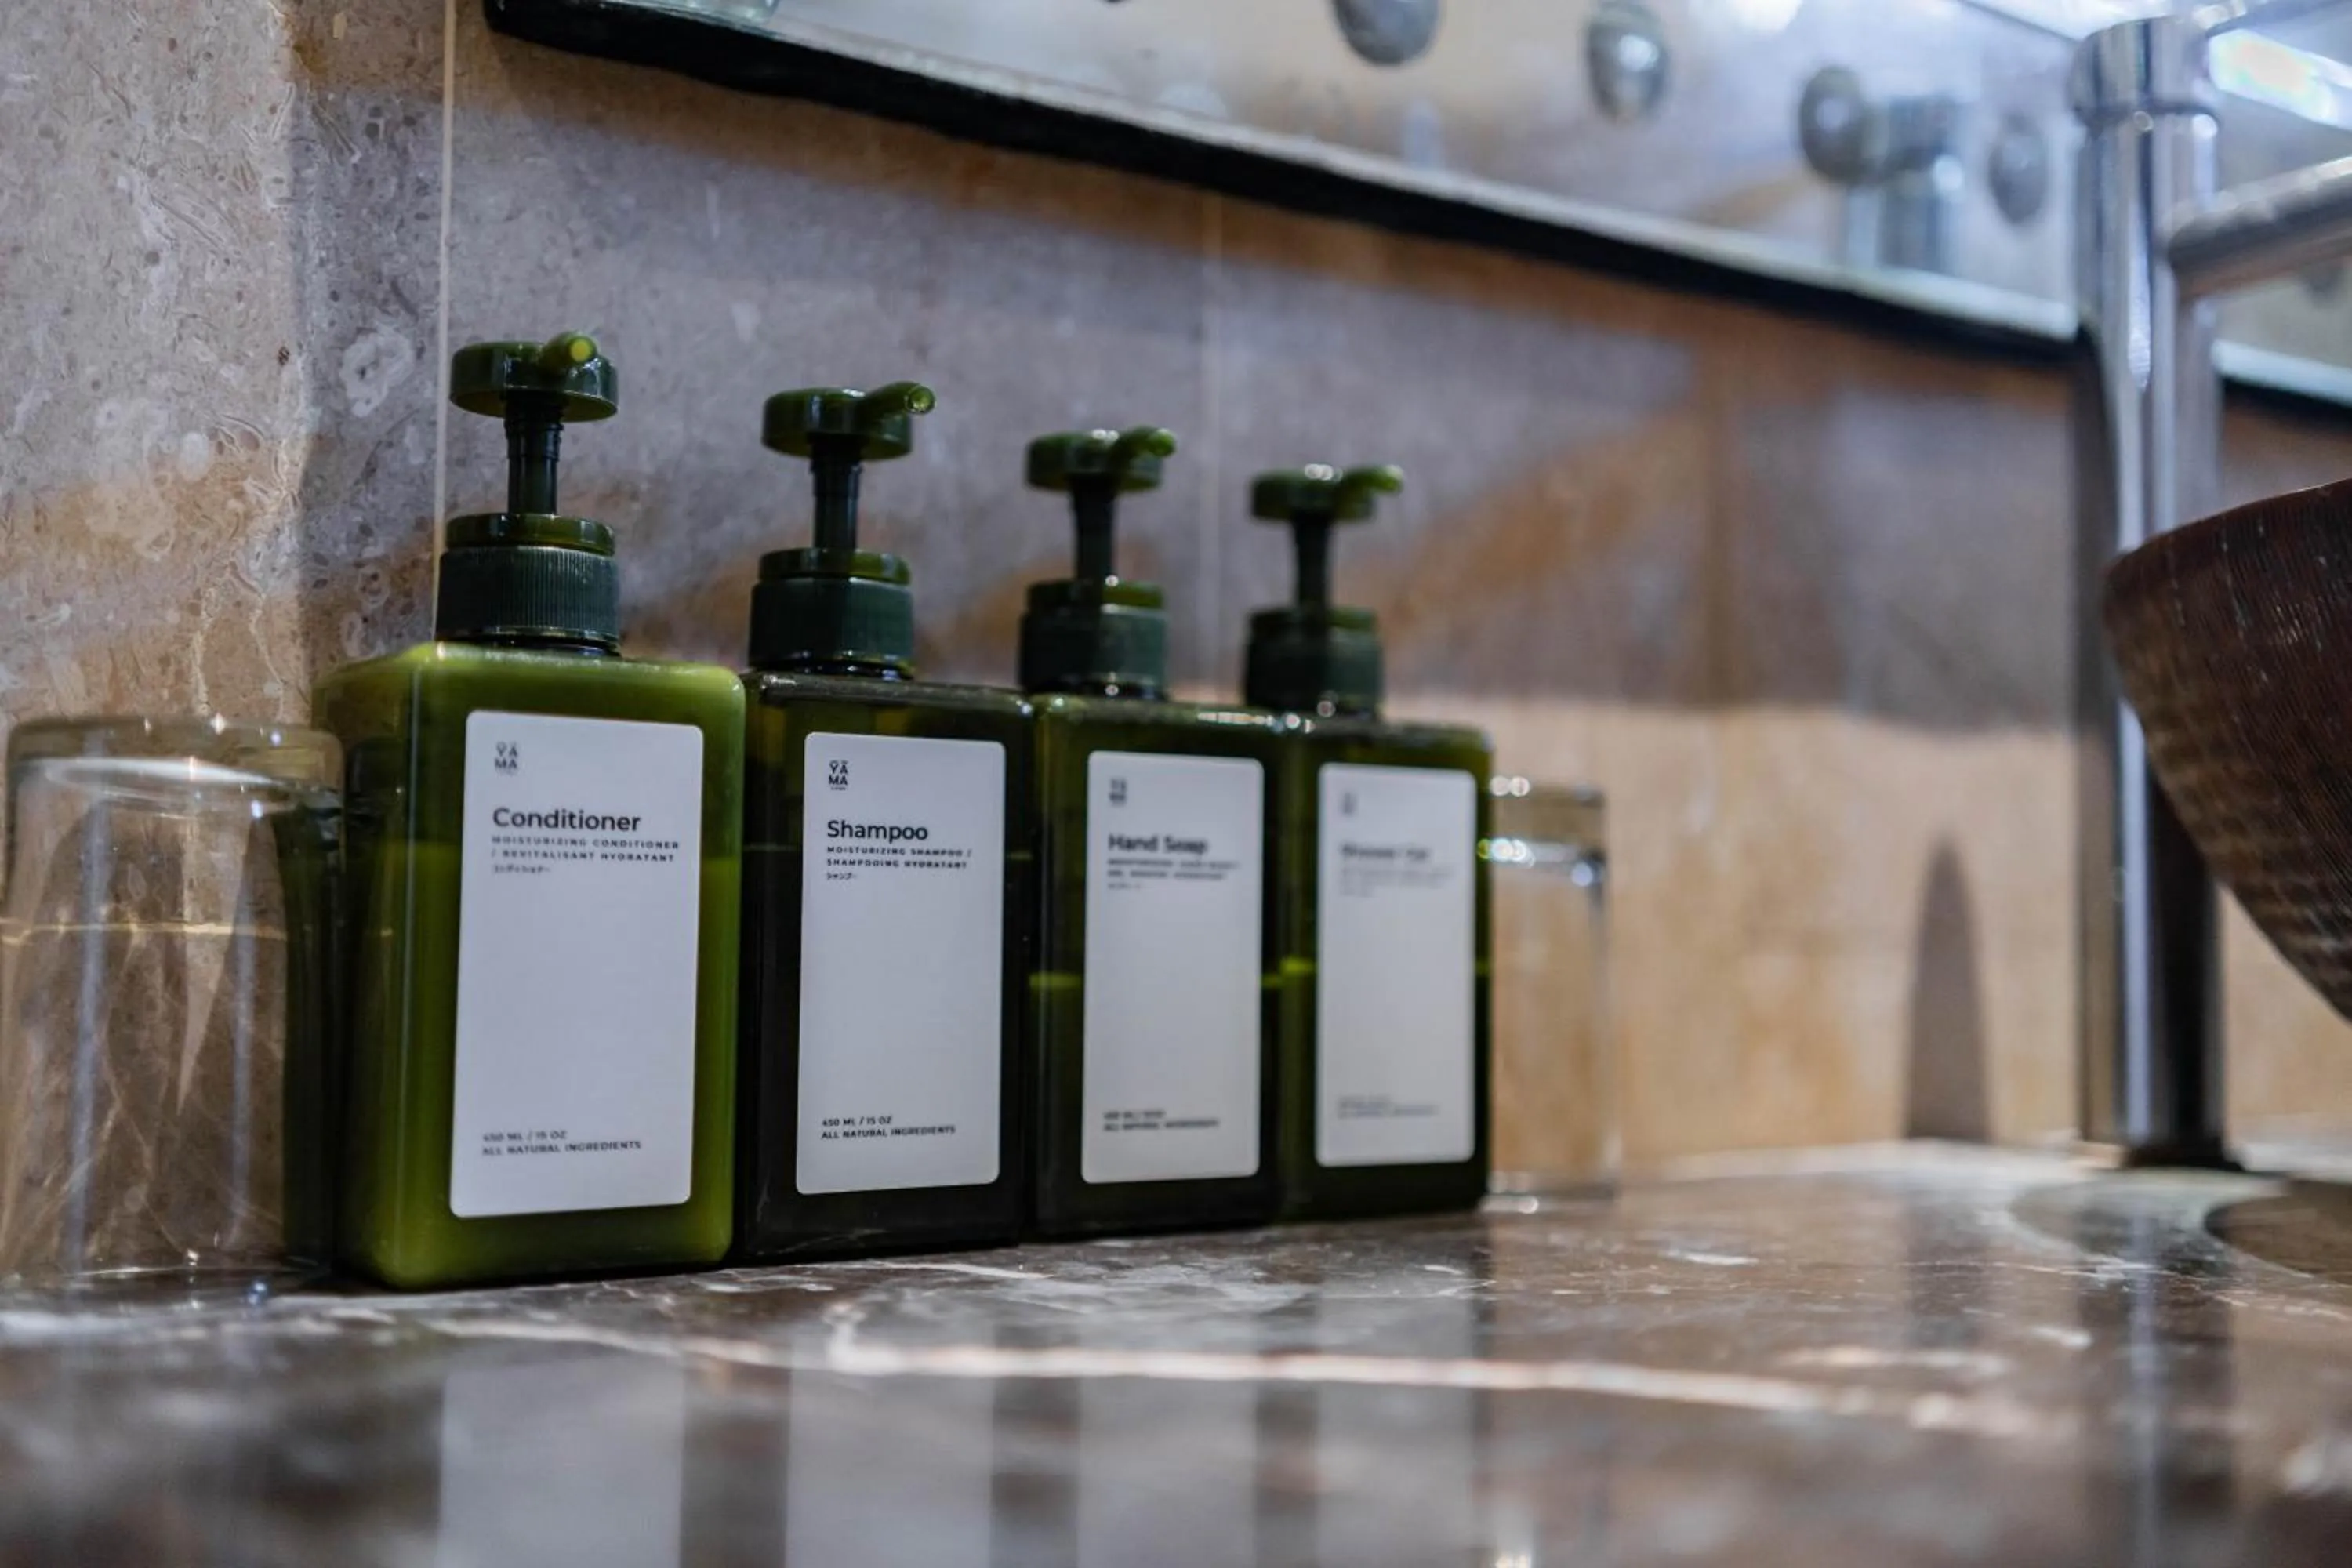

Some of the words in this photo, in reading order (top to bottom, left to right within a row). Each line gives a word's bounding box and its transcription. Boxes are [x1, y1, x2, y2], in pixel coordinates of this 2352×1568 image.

[492, 807, 641, 831] Conditioner
[827, 819, 928, 844] Shampoo
[492, 836, 586, 847] MOISTURIZING
[592, 838, 679, 849] CONDITIONER
[1108, 833, 1158, 852] Hand
[1163, 835, 1208, 856] Soap
[601, 852, 674, 862] HYDRATANT
[827, 846, 905, 855] MOISTURIZING
[910, 848, 963, 857] SHAMPOO
[827, 858, 899, 867] SHAMPOOING
[843, 1129, 887, 1138] NATURAL
[506, 1143, 561, 1155] NATURAL
